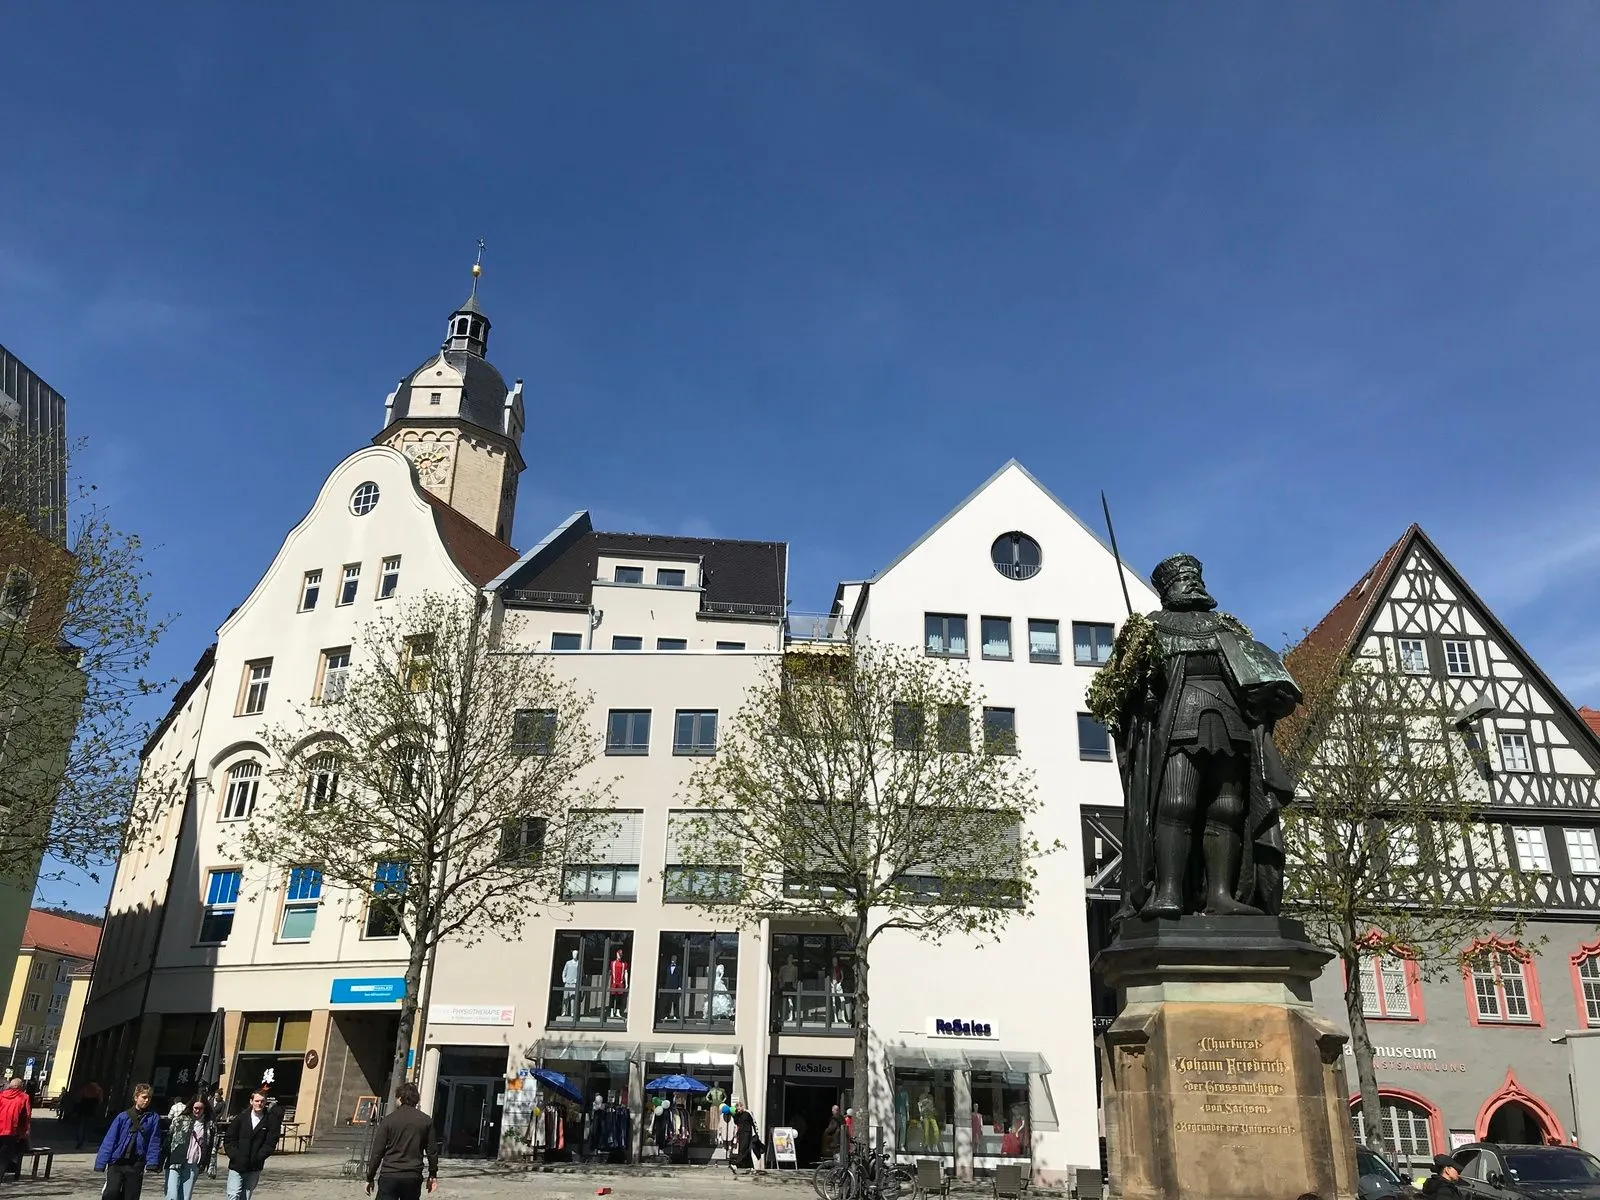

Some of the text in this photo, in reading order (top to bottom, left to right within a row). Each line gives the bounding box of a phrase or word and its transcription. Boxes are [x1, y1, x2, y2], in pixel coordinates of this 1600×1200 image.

[936, 1018, 992, 1036] ReSales
[794, 1062, 833, 1074] ReSales
[1174, 1057, 1286, 1076] Johann Friedrich
[1184, 1080, 1204, 1092] der
[1205, 1103, 1267, 1116] von Sachsen
